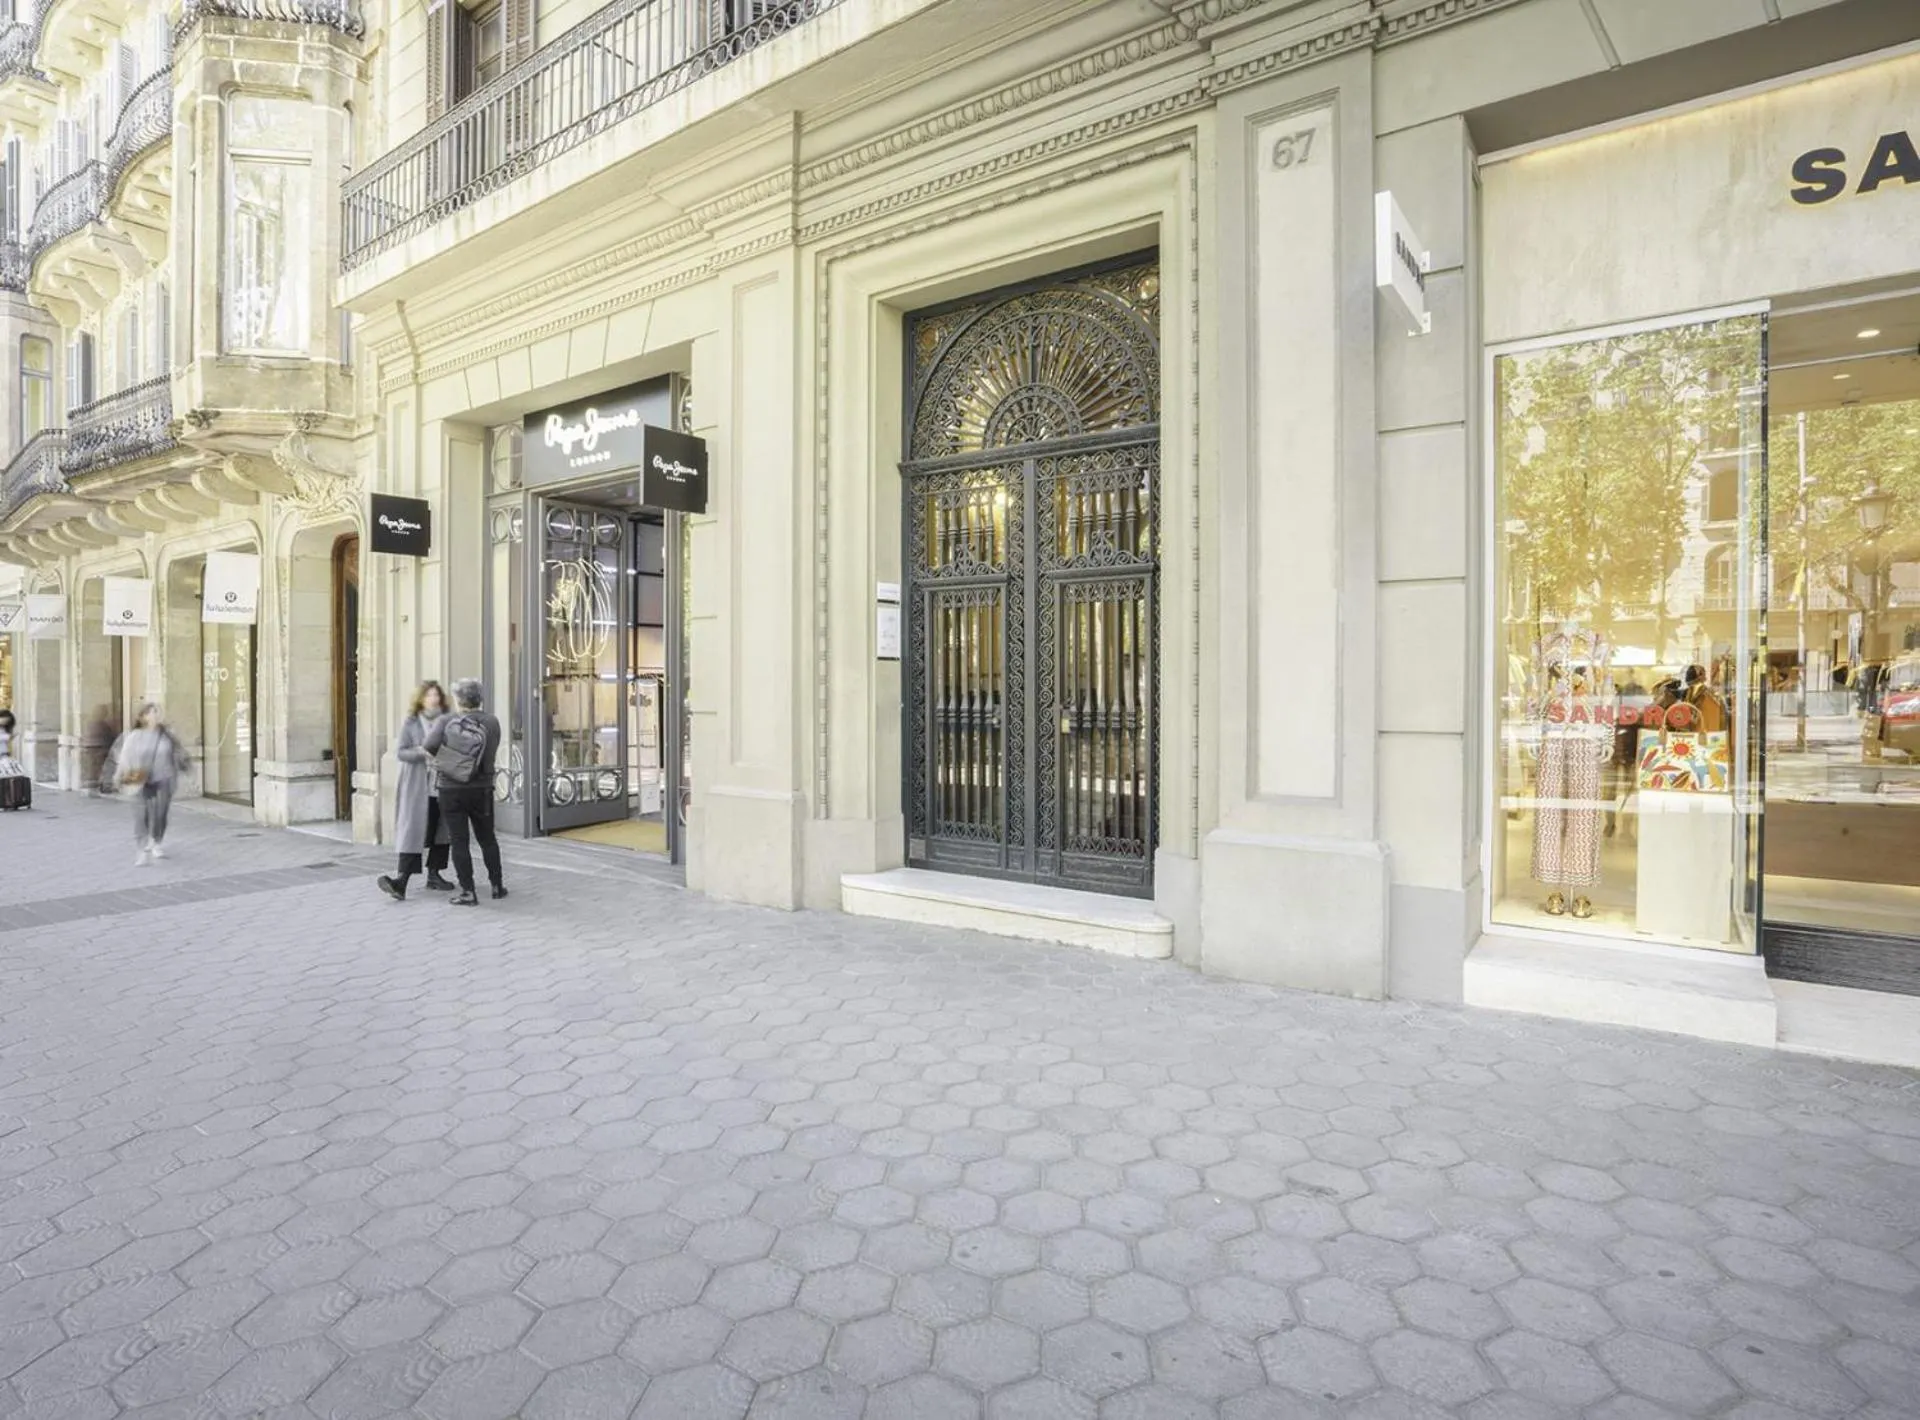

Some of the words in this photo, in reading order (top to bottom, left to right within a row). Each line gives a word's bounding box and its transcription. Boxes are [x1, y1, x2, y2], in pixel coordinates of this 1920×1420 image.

[1272, 127, 1316, 170] 67
[1790, 130, 1920, 205] SA
[1547, 703, 1692, 727] SANDRO
